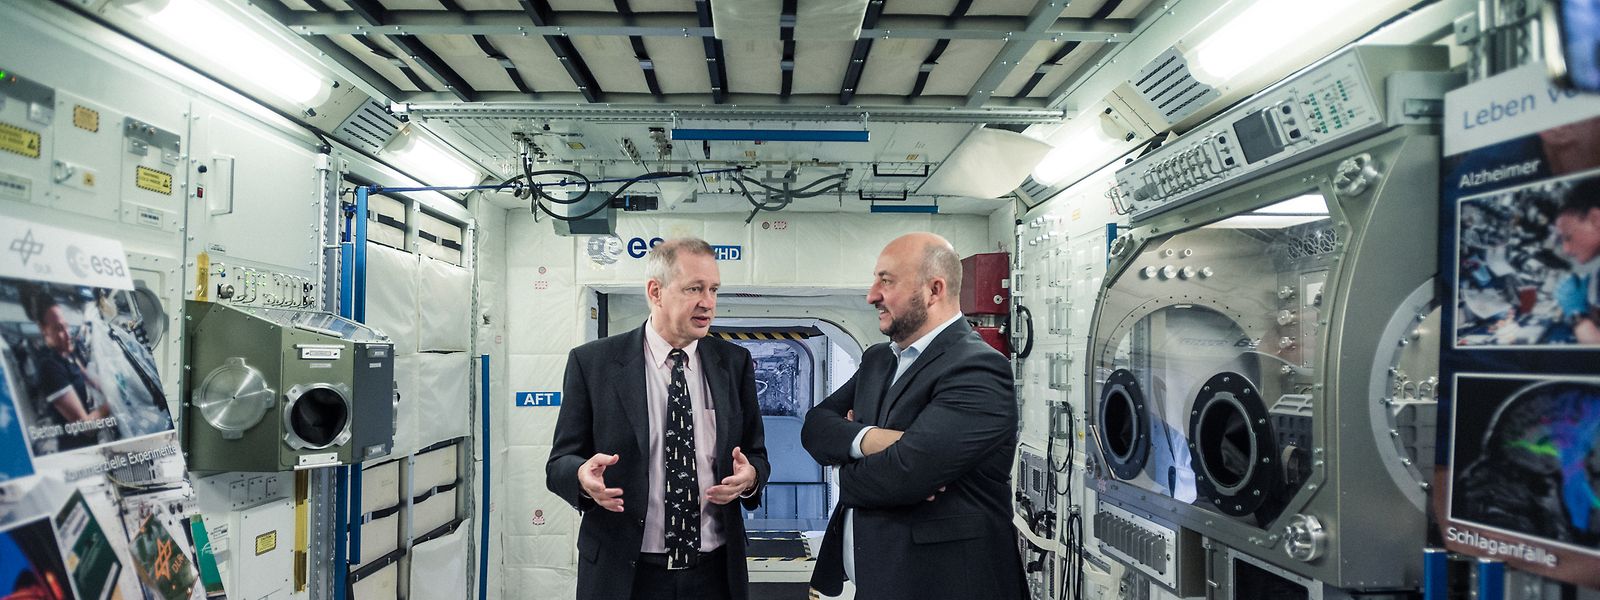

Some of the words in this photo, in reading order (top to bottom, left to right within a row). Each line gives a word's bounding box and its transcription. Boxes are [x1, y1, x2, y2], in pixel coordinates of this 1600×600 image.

[1463, 94, 1535, 129] Leben
[1460, 160, 1540, 188] Alzheimer
[91, 255, 125, 277] esa
[523, 393, 554, 405] AFT
[29, 423, 63, 440] Beton
[64, 416, 118, 435] optimieren
[127, 444, 178, 465] Experimente
[1447, 527, 1557, 567] Schlaganfälle
[171, 553, 187, 574] DLR
